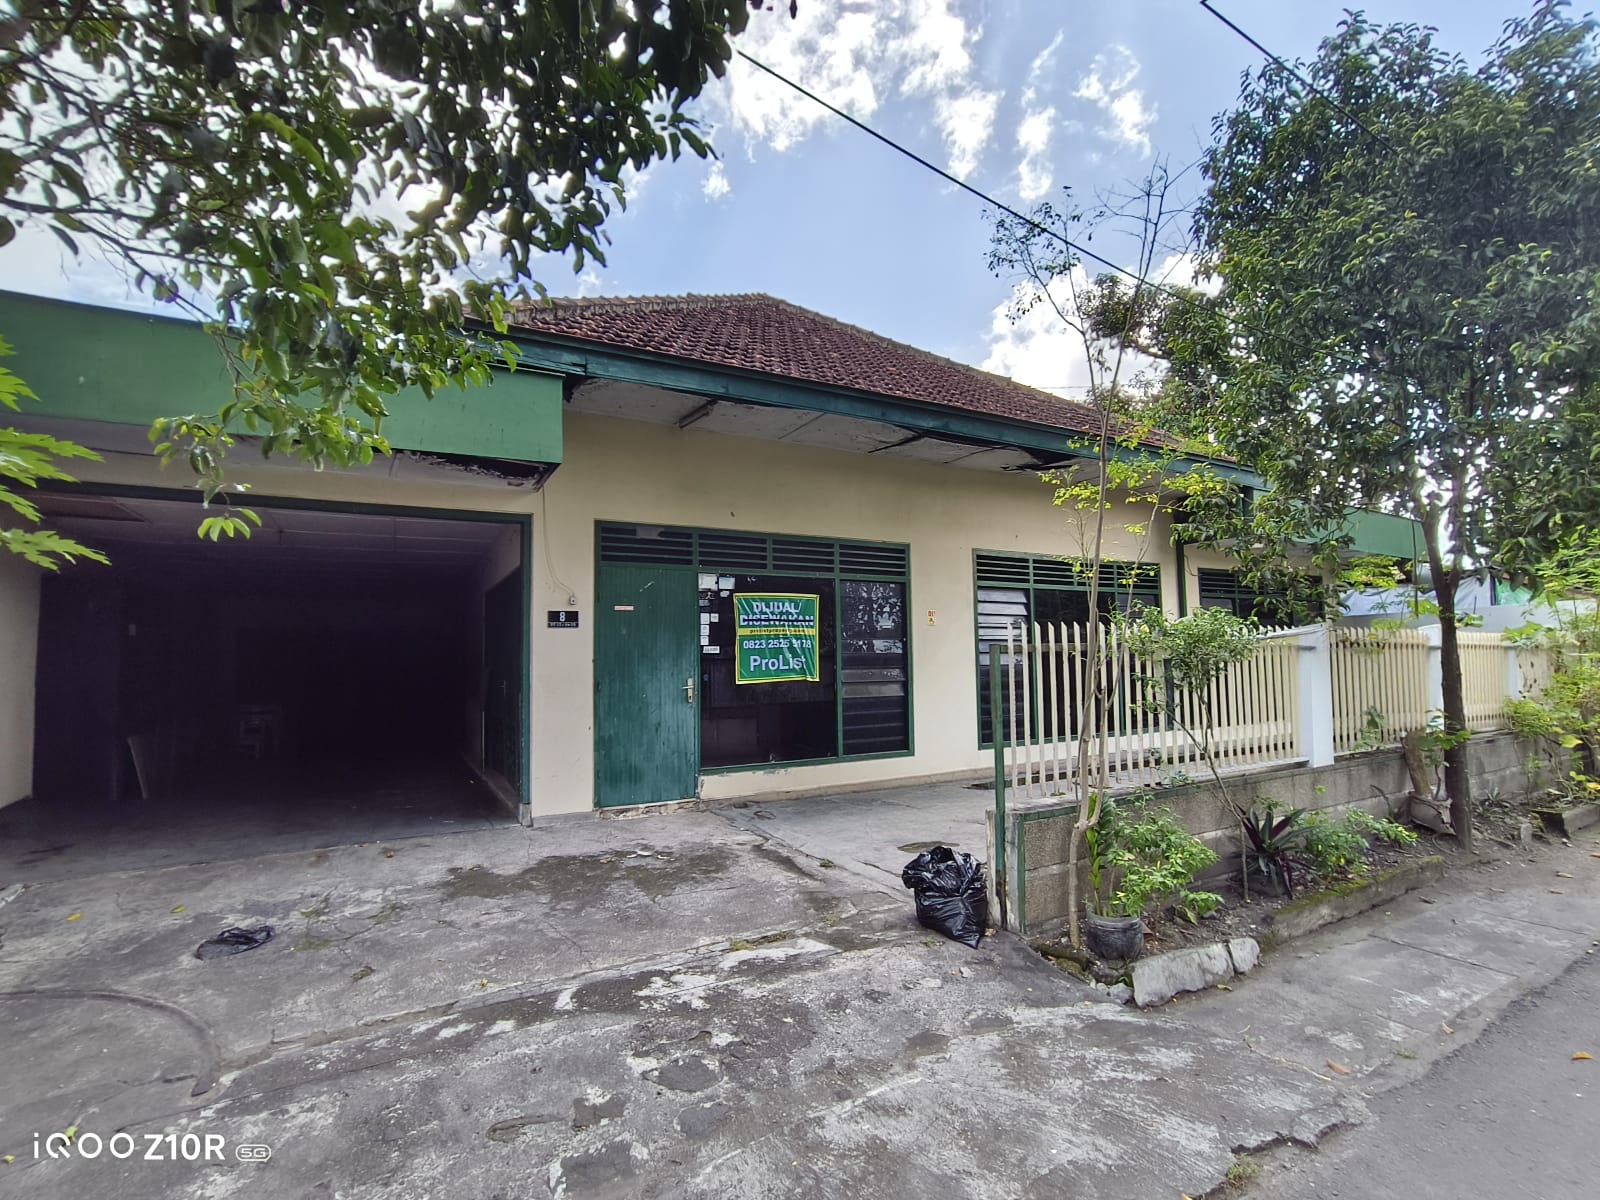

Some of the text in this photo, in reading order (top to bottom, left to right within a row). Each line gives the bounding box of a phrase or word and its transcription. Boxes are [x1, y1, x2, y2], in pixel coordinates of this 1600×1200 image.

[559, 611, 566, 622] 8
[740, 615, 814, 625] DISEWAKAN
[743, 639, 766, 649] 0823
[768, 639, 790, 648] 2525
[750, 654, 805, 671] ProList
